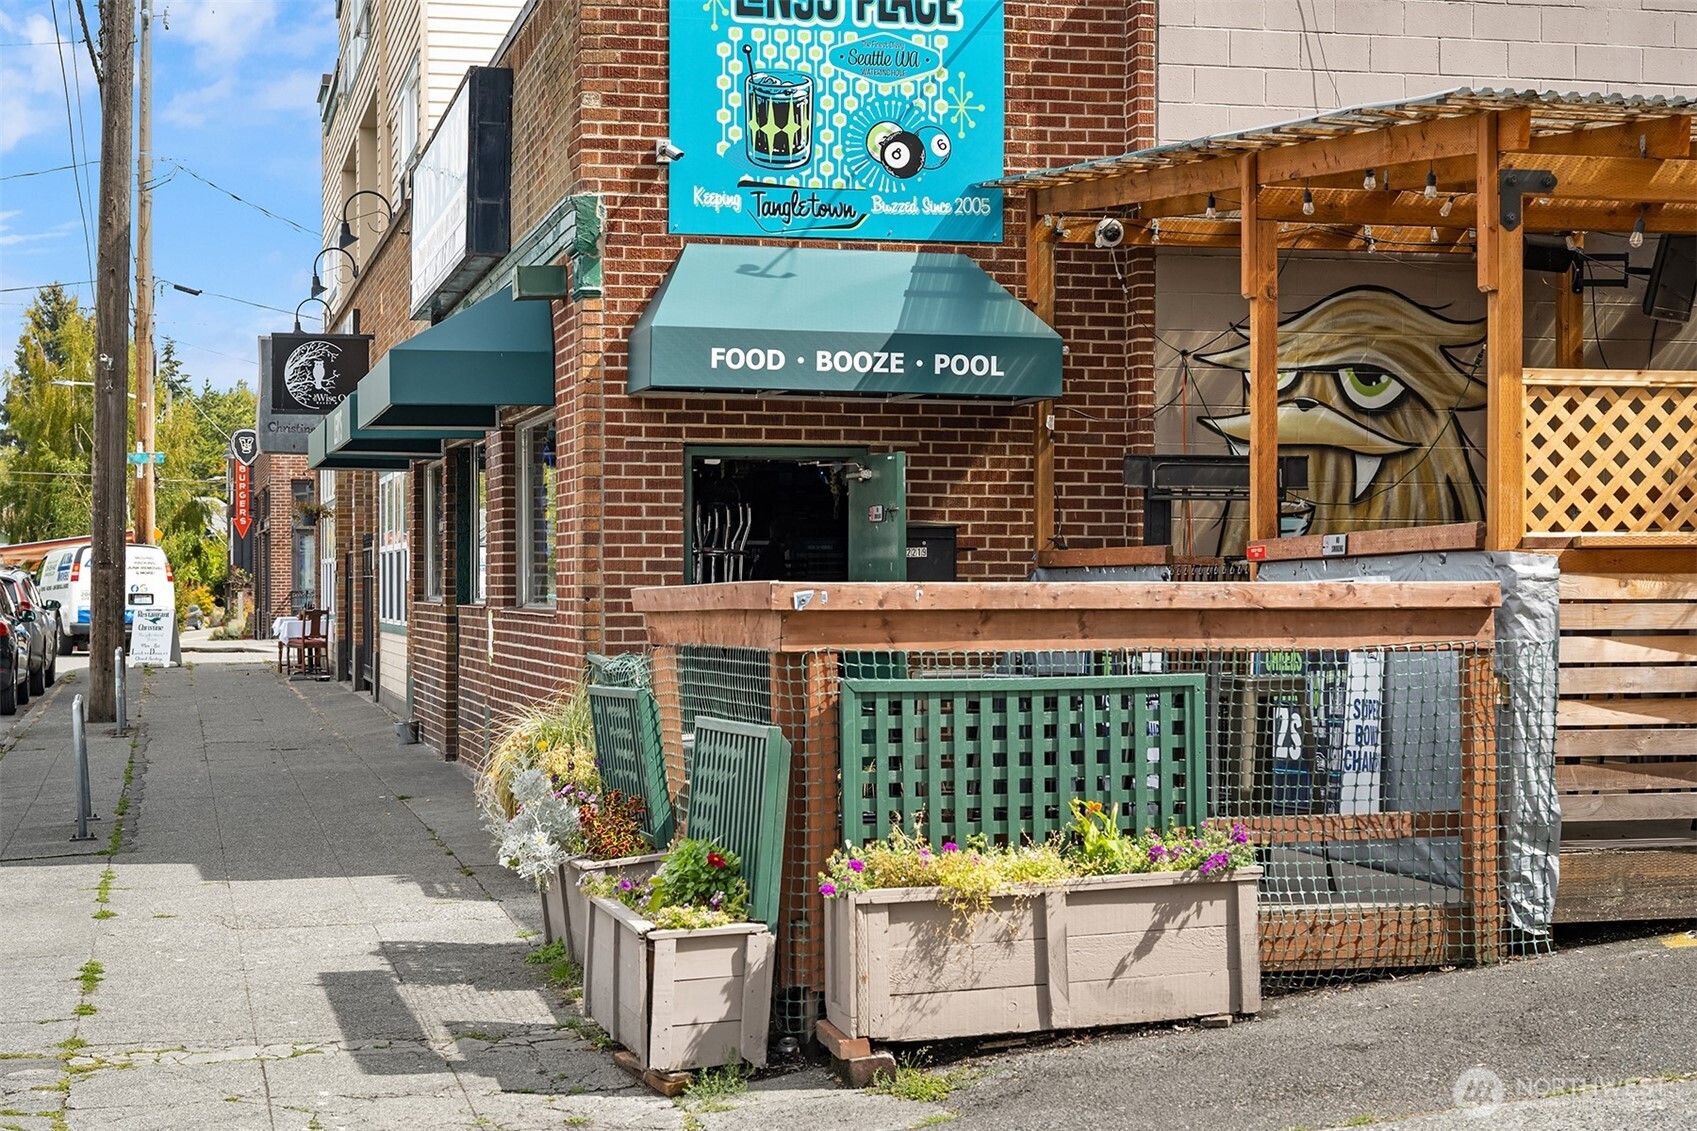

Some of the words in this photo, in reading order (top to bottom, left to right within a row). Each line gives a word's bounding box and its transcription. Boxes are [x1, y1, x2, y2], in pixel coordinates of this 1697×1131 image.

[847, 48, 893, 67] Seattle
[895, 51, 921, 68] WA
[861, 68, 891, 77] WATERING
[892, 69, 907, 77] HOLE
[936, 138, 947, 151] 6
[693, 186, 742, 213] Keeping
[750, 190, 859, 225] Tangletown
[871, 195, 918, 216] Buzzed
[922, 196, 953, 216] Since
[954, 197, 991, 216] 2005
[711, 347, 786, 371] FOOD
[816, 350, 905, 374] BOOZE
[934, 353, 1005, 377] POOL
[316, 393, 337, 402] Wise
[238, 465, 247, 525] BURGERS
[906, 547, 927, 557] 2219
[137, 610, 170, 618] Restaurant
[138, 623, 164, 631] Christine
[1355, 724, 1378, 746] BOW
